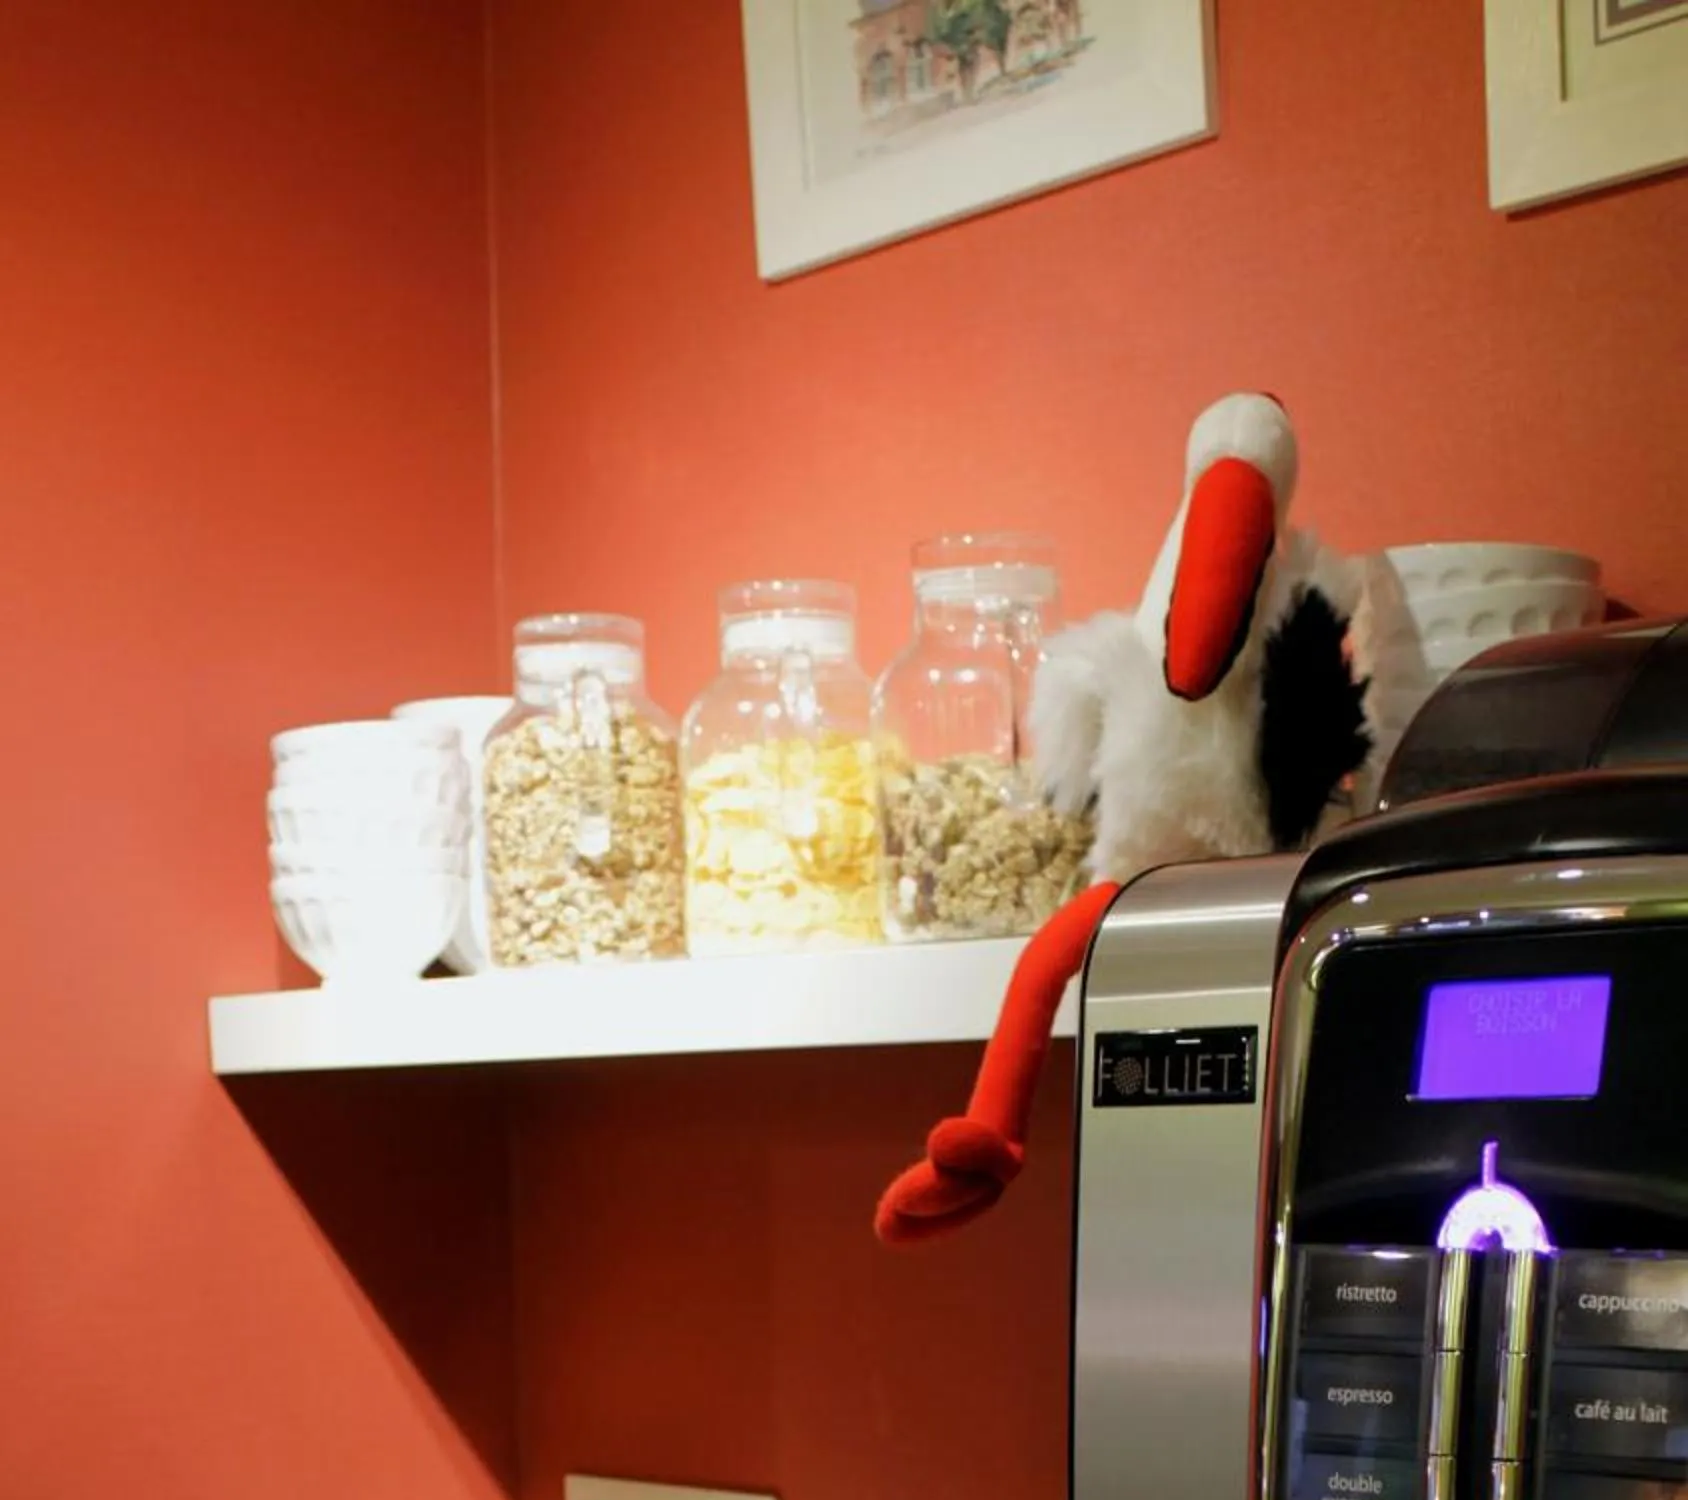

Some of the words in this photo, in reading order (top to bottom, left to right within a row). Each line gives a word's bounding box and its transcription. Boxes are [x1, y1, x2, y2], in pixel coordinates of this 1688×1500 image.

[1336, 1282, 1398, 1303] ristretto
[1327, 1386, 1394, 1406] espresso
[1574, 1400, 1611, 1421] café
[1613, 1407, 1637, 1422] au
[1640, 1402, 1669, 1424] lait
[1327, 1472, 1383, 1494] double
